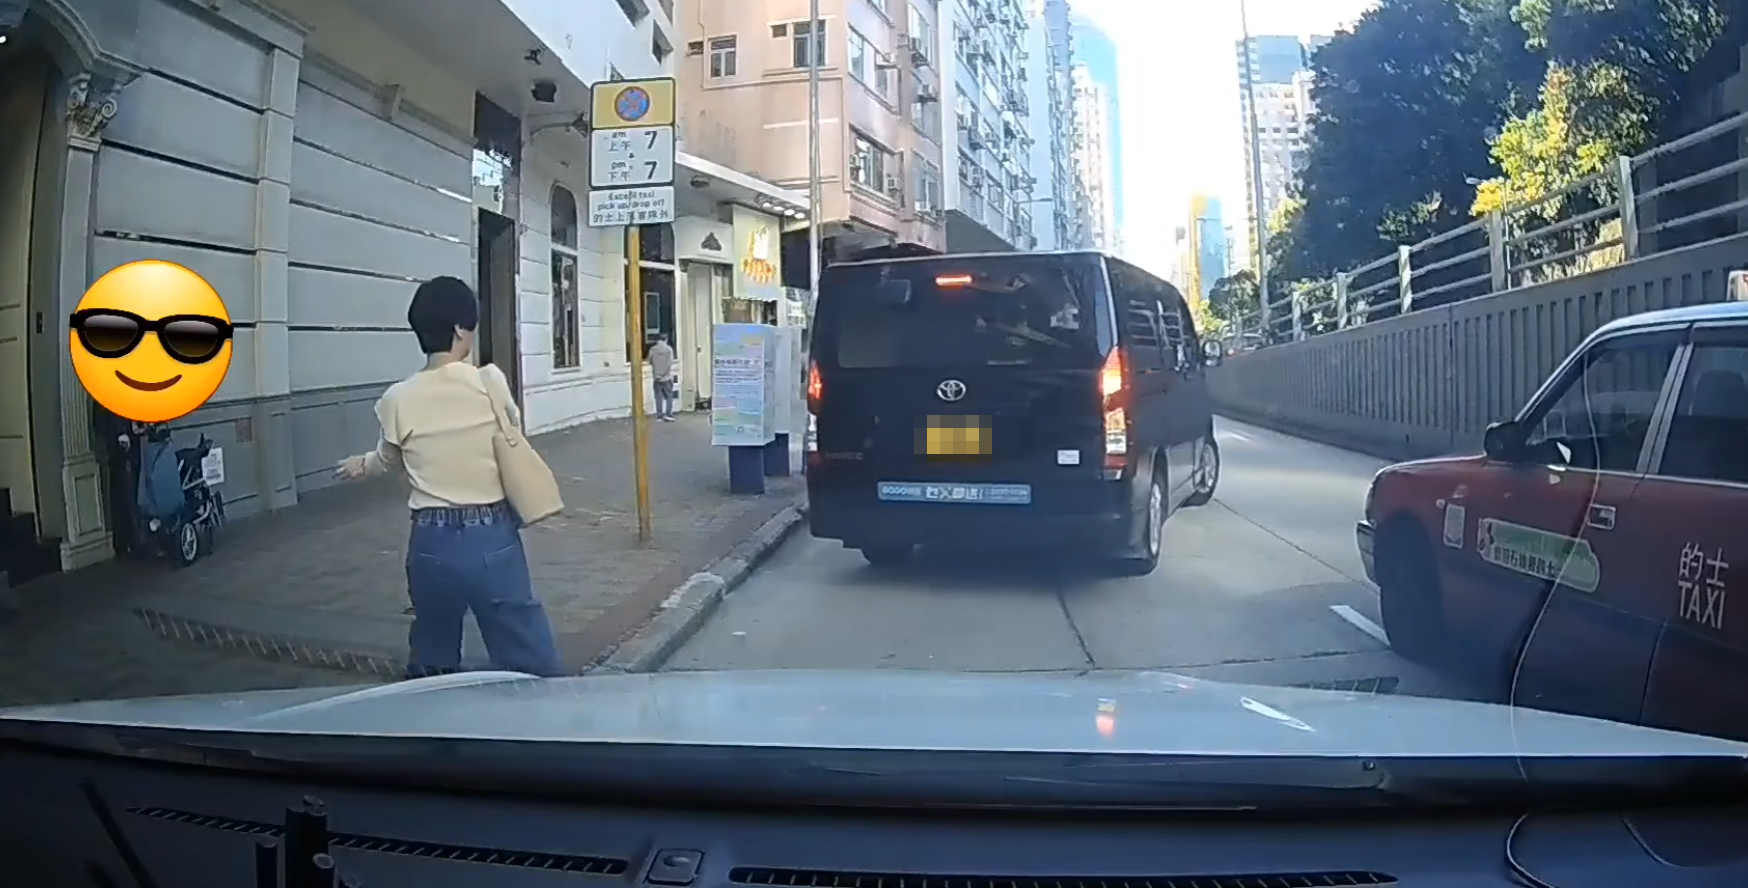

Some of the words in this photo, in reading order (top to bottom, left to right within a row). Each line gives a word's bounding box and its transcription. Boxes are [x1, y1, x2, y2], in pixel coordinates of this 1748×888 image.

[607, 141, 631, 151] 上午
[644, 130, 657, 149] 7
[608, 171, 630, 182] 下午
[644, 161, 657, 179] 7
[825, 451, 864, 461] HCE
[1679, 542, 1729, 587] 的士
[1678, 581, 1725, 630] TAXI
